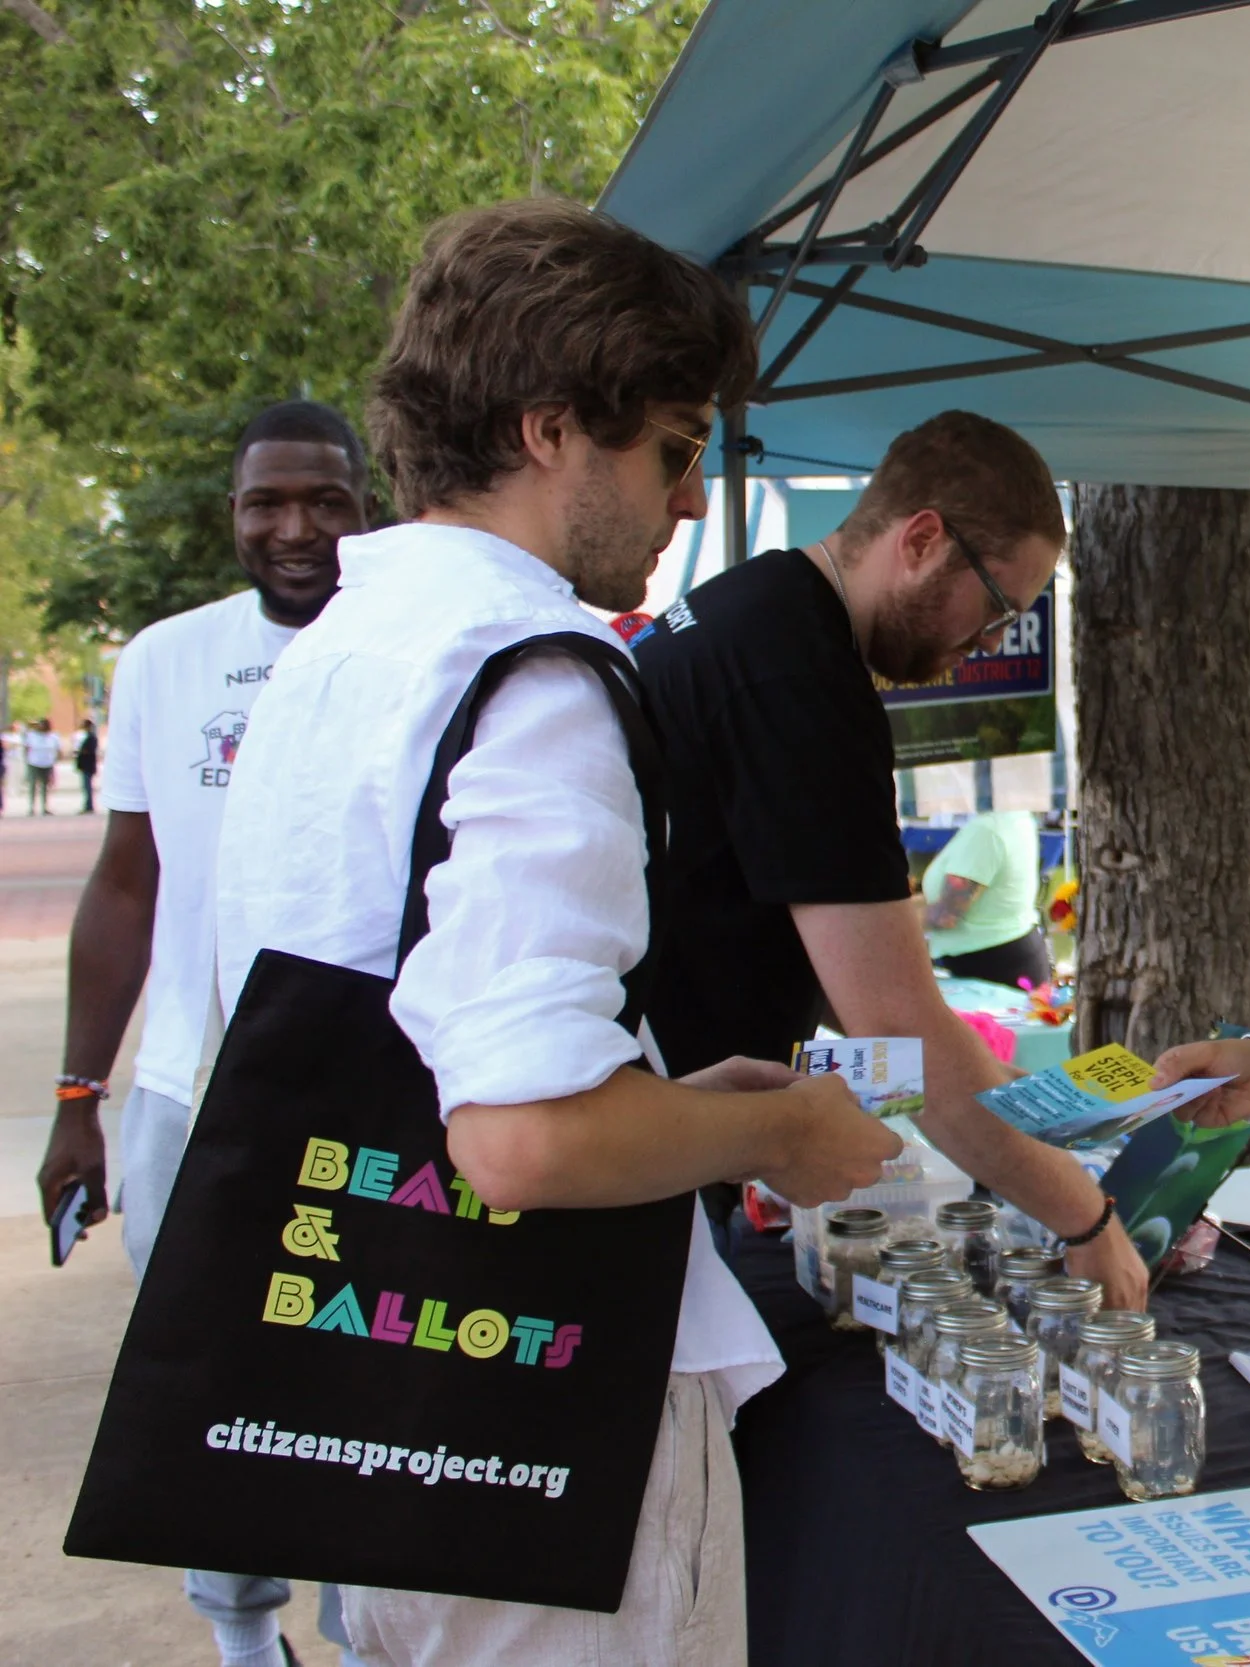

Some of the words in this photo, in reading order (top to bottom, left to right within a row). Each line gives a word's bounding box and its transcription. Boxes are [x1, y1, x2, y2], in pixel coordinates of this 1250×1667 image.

[1085, 1064, 1125, 1093] VIGIL
[1097, 1056, 1145, 1087] STEPH
[282, 1204, 340, 1261] &
[262, 1272, 582, 1368] BALLOTS
[206, 1418, 569, 1498] citizensproject.org
[1075, 1519, 1125, 1545] TO
[1103, 1543, 1180, 1590] YOU?
[1119, 1514, 1218, 1583] IMPORTANT
[1152, 1510, 1219, 1553] ISSUES
